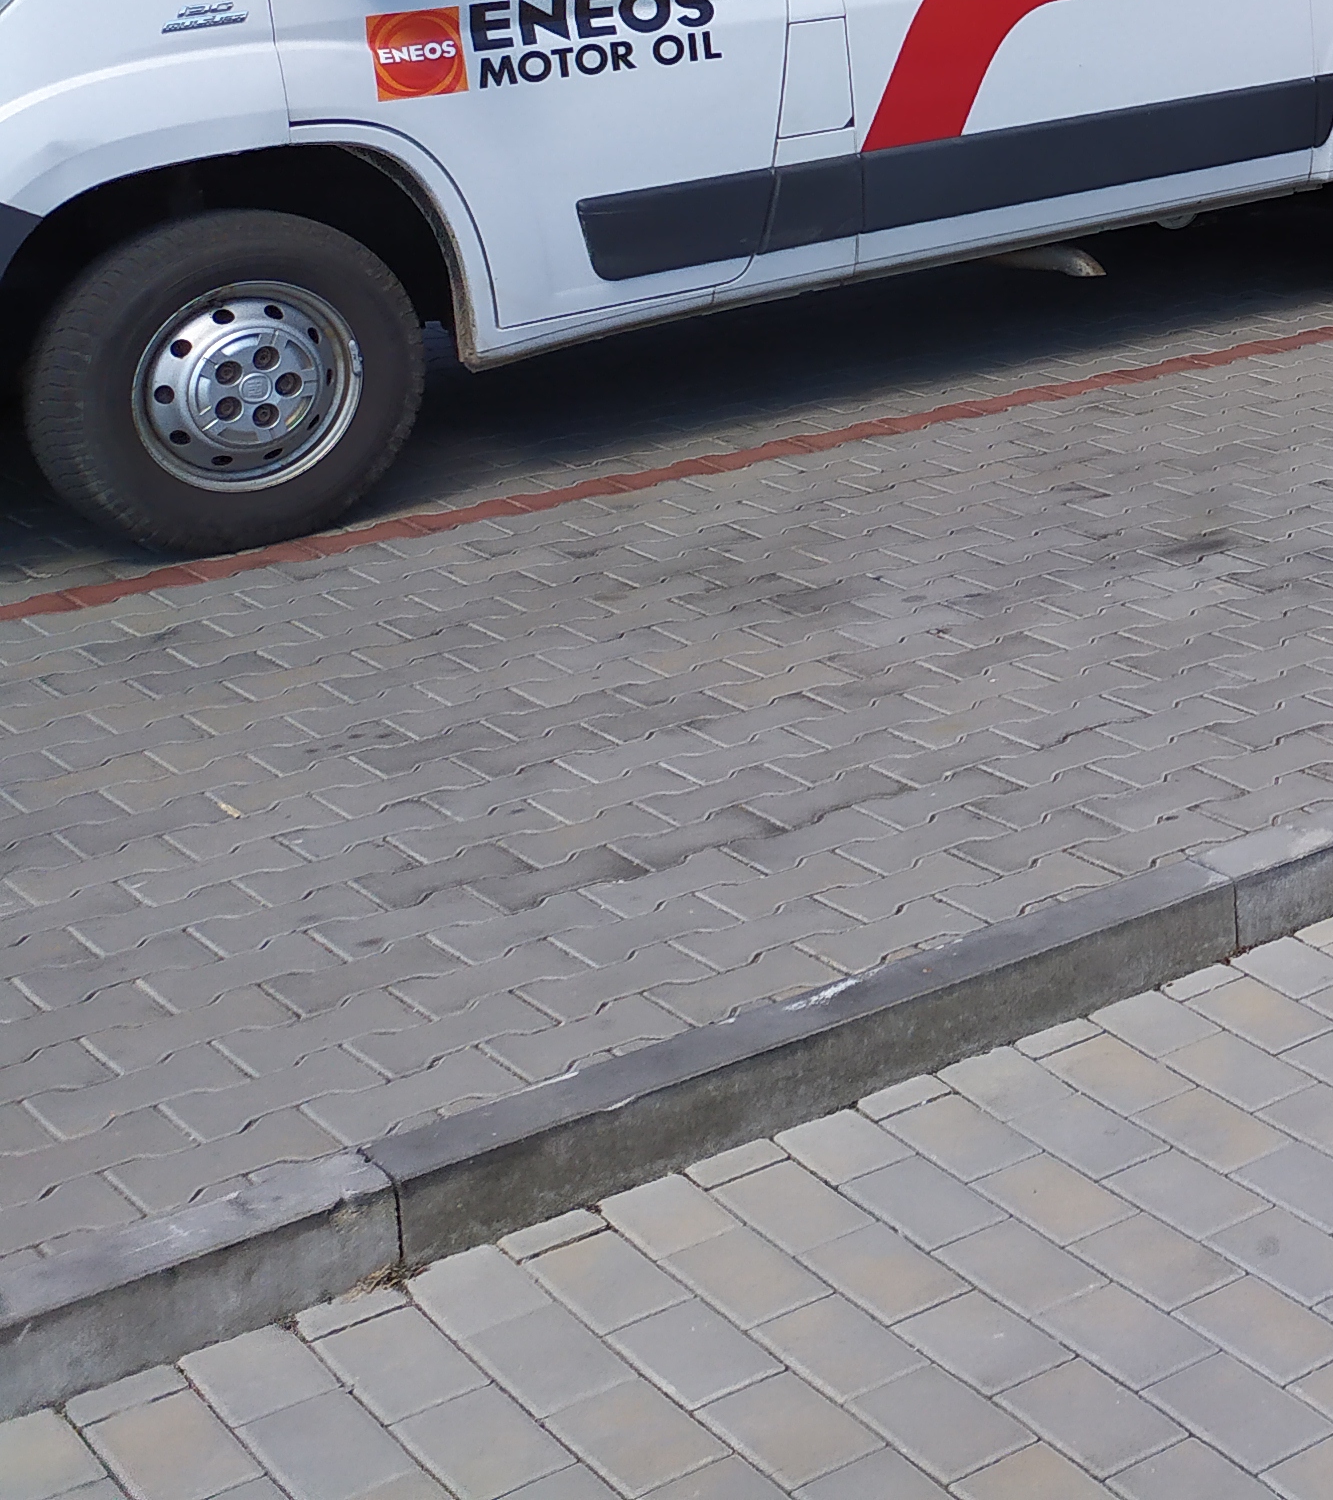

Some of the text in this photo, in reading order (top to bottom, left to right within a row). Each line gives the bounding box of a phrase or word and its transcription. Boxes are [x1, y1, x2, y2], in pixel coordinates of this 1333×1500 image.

[376, 42, 457, 65] ENEOS
[479, 31, 722, 89] MOTOR OIL
